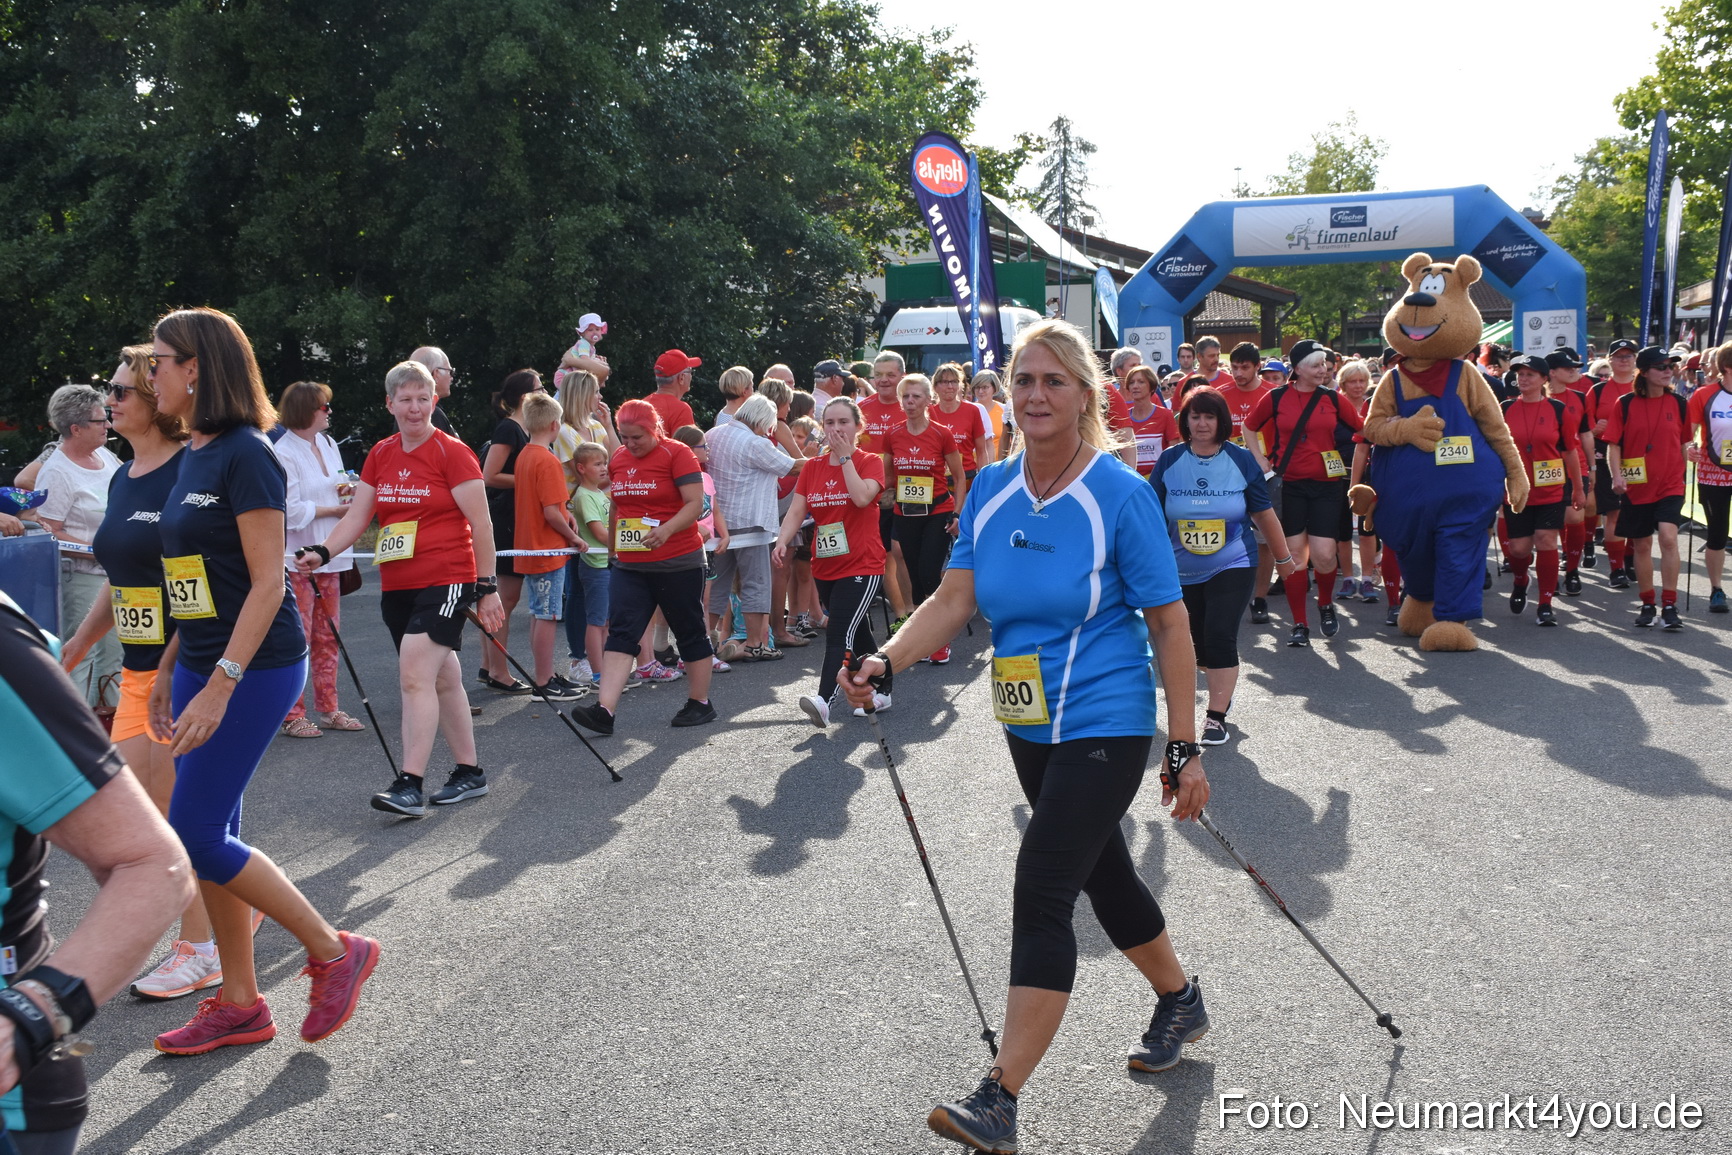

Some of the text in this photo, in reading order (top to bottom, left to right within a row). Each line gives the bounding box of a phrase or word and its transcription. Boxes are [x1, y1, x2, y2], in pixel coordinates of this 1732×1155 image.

[1338, 214, 1365, 222] Fischer
[1317, 226, 1399, 244] firmenlauf
[1165, 262, 1208, 273] Fischer
[892, 328, 924, 336] abavent
[1440, 446, 1468, 457] 2340
[1538, 468, 1562, 480] 2366
[394, 484, 430, 496] Handwerk
[624, 480, 658, 490] Handwerk
[904, 486, 925, 496] 593
[620, 530, 641, 542] 590
[1184, 532, 1219, 545] 2112
[381, 536, 404, 552] 606
[1028, 541, 1056, 553] classic
[170, 579, 197, 602] 437
[115, 607, 153, 628] 1395
[993, 680, 1032, 706] 1080
[1172, 744, 1180, 767] LEKI
